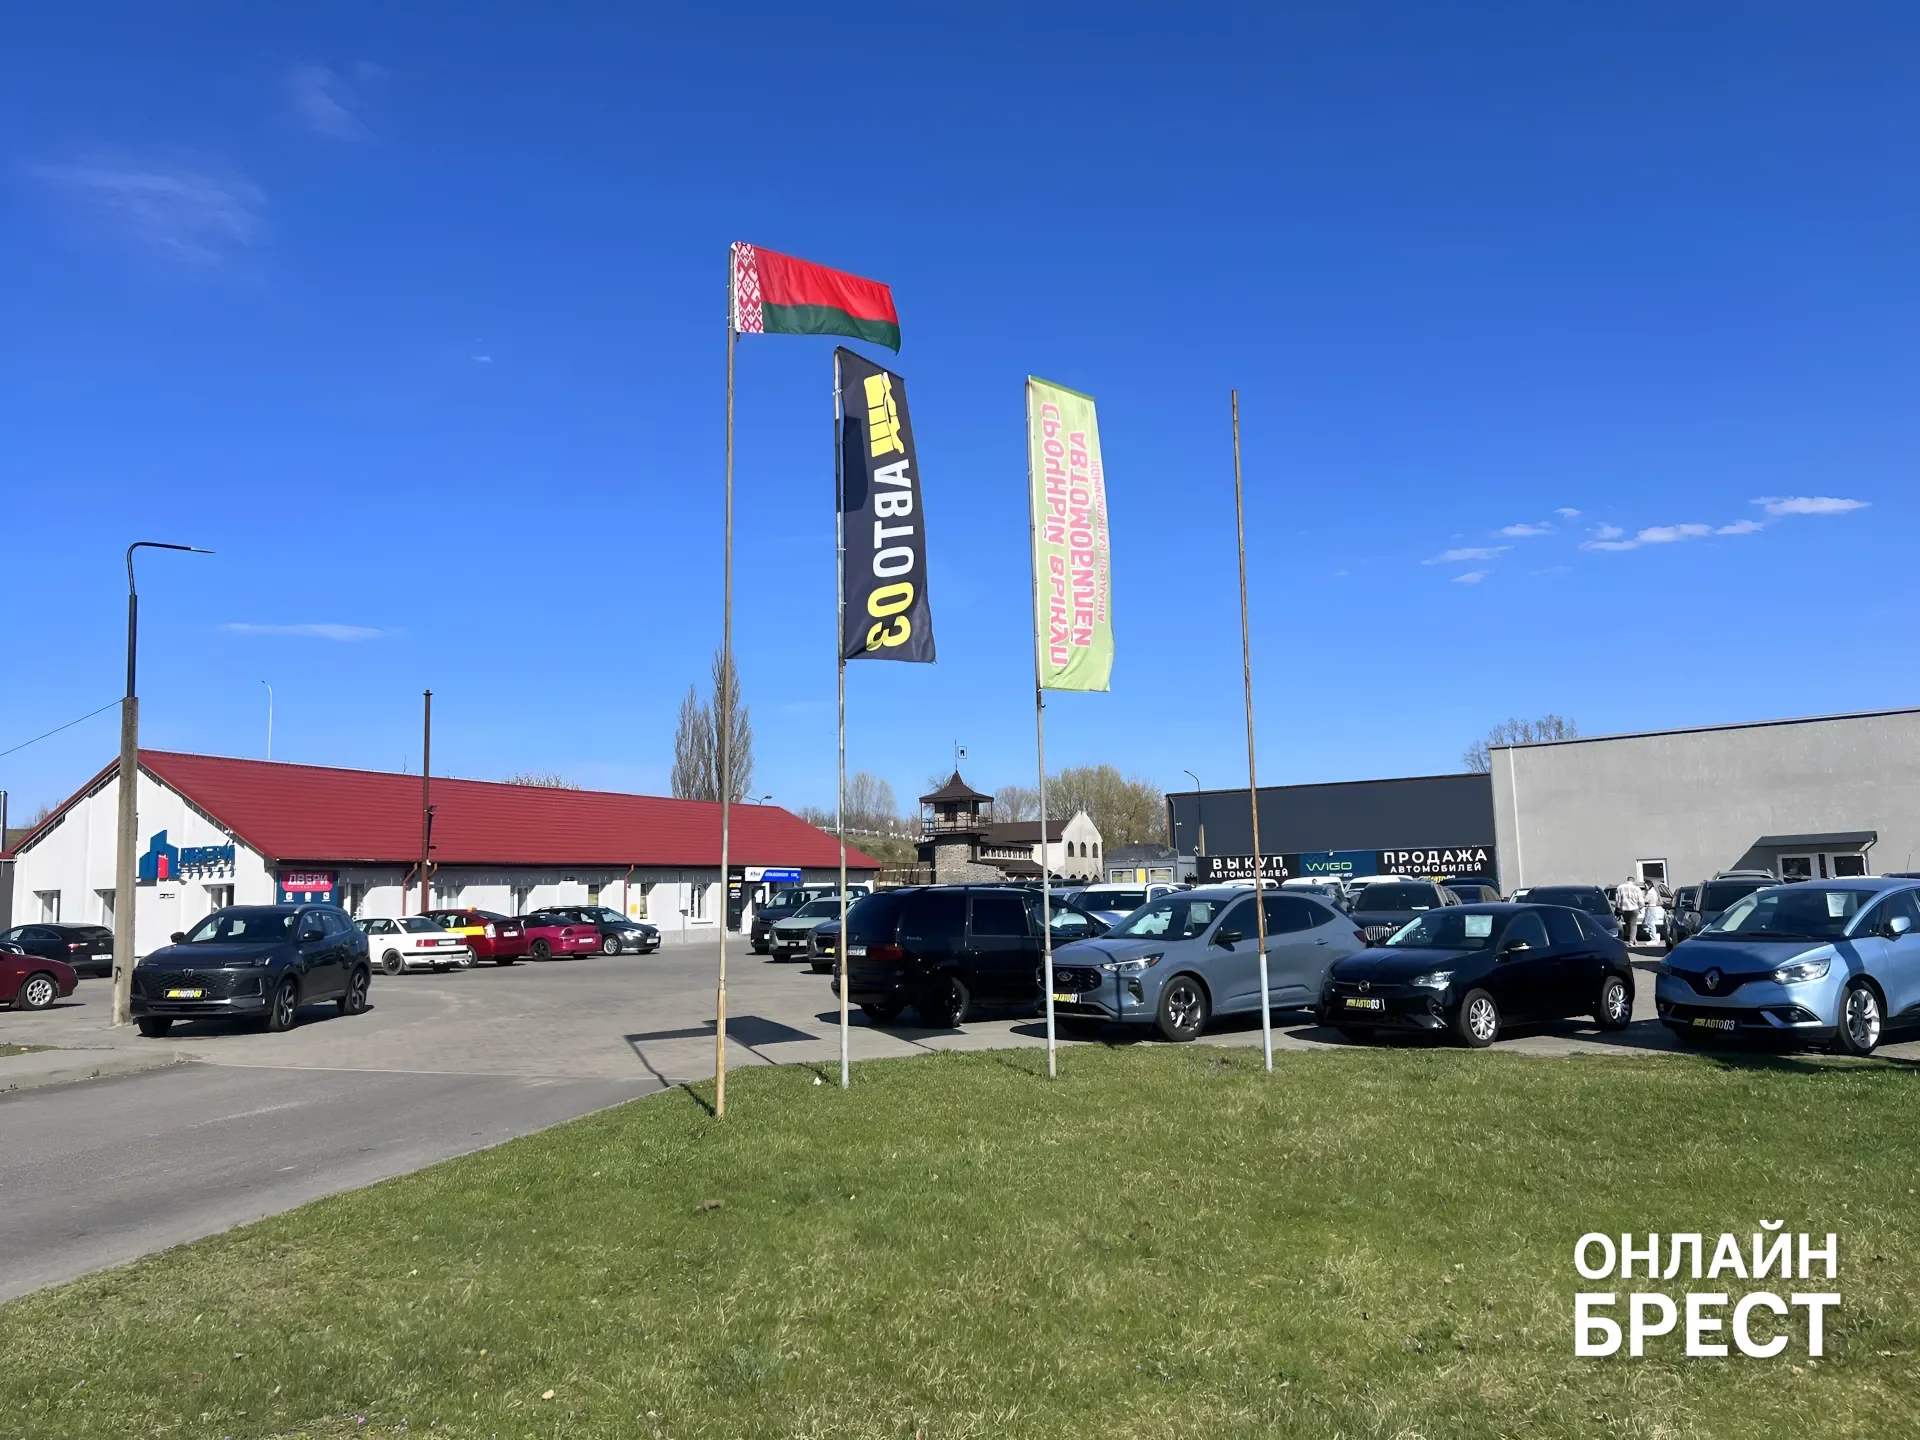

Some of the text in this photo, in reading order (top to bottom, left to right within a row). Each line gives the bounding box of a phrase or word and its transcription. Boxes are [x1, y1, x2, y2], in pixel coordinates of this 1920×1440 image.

[1384, 849, 1488, 865] ПРОДАЖА
[1212, 856, 1284, 870] ВЫКУП
[1306, 862, 1352, 872] WIGO
[1390, 862, 1482, 874] АВТОМОБИЛЕЙ
[1209, 868, 1289, 879] АВТОМОИЛЕЙ
[287, 874, 328, 885] ДВЕРИ
